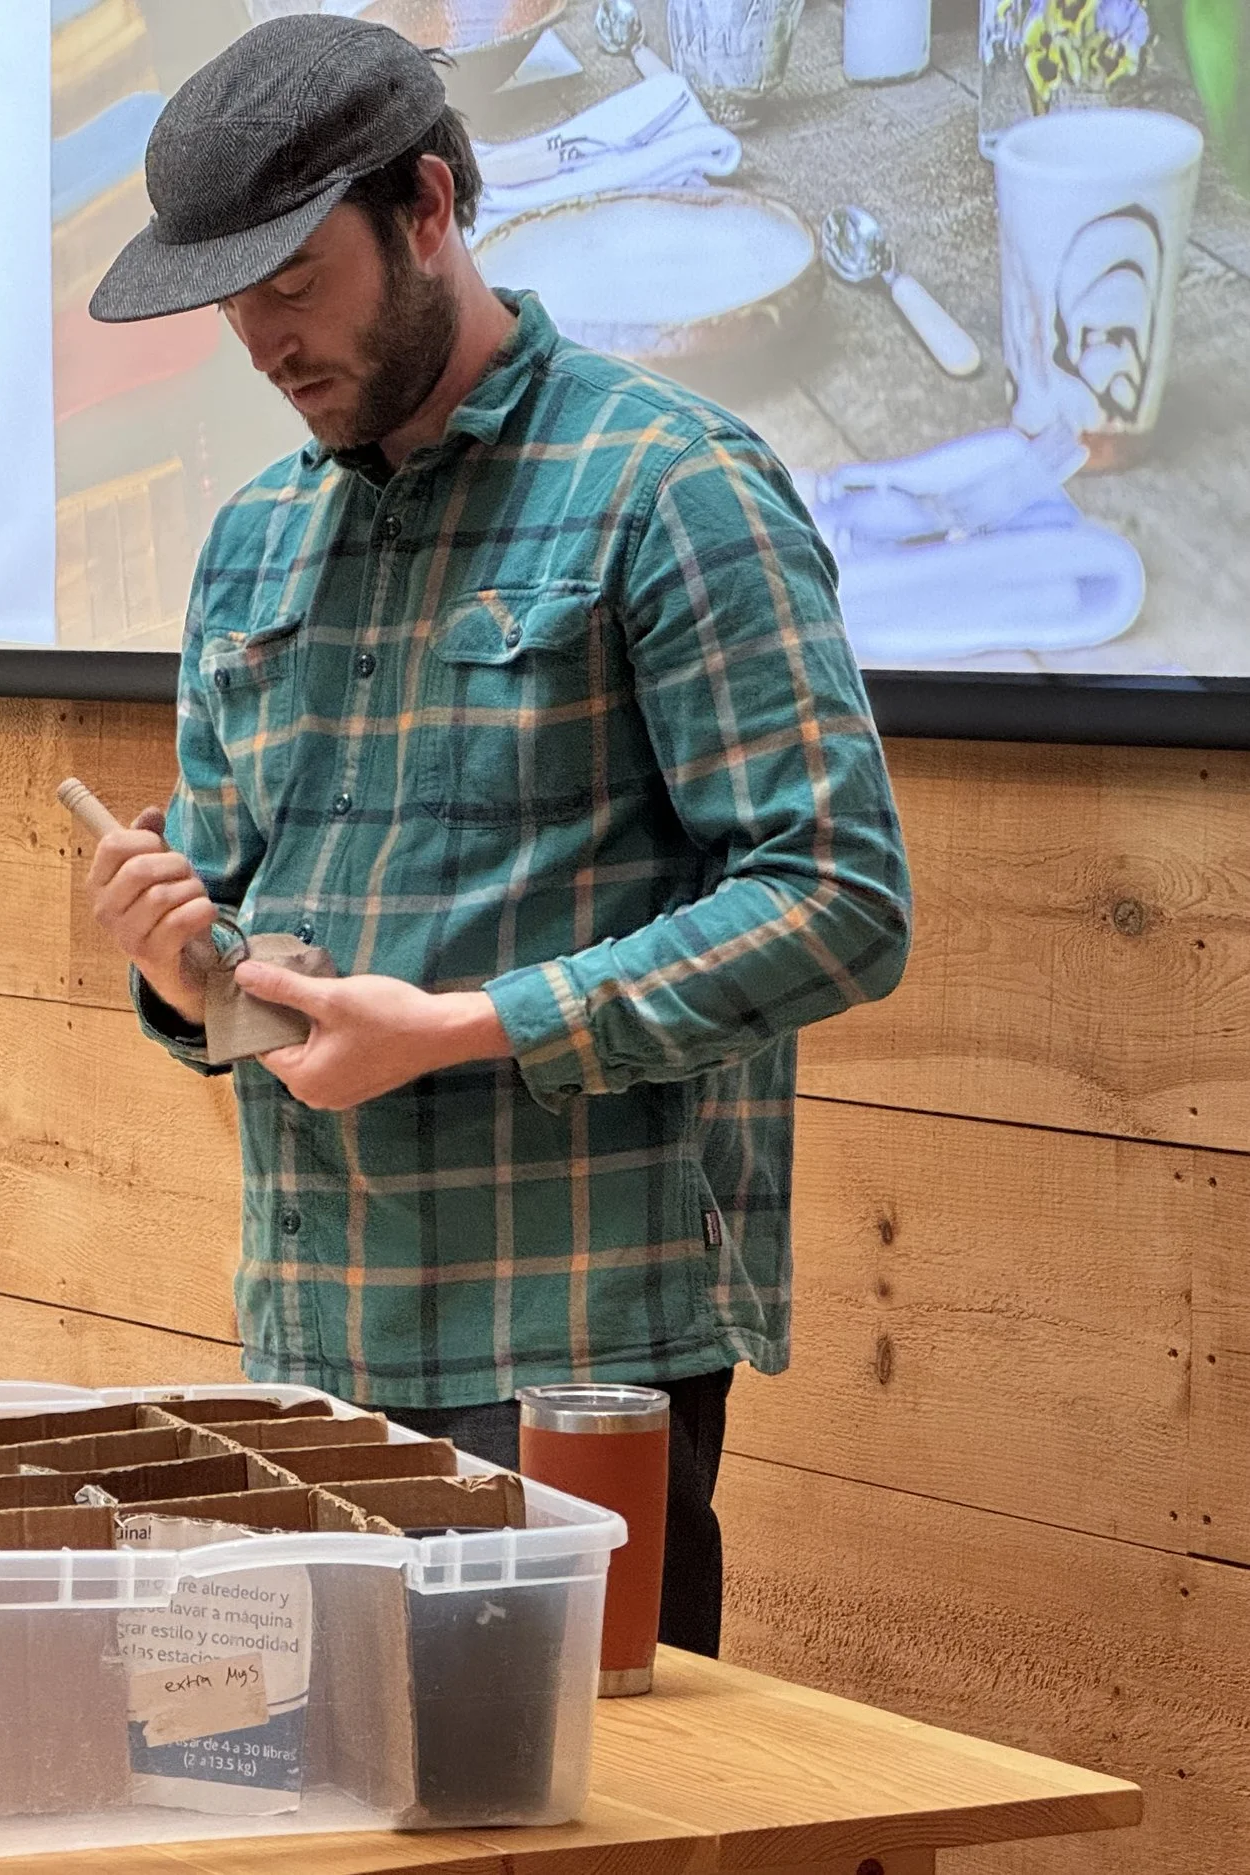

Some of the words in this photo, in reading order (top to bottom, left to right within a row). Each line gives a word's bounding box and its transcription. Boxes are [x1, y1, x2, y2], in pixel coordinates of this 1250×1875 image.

[202, 1582, 276, 1602] alrededor
[279, 1593, 289, 1609] y
[170, 1600, 207, 1618] lavar
[212, 1608, 221, 1620] a
[225, 1611, 292, 1630] máquina
[151, 1625, 193, 1641] estilo
[197, 1630, 207, 1646] y
[211, 1633, 299, 1653] comodidad
[164, 1674, 212, 1692] extra
[203, 1738, 219, 1751] de
[221, 1741, 230, 1752] 4
[232, 1743, 240, 1754] a
[243, 1743, 260, 1757] 30
[262, 1745, 297, 1761] libras
[237, 1760, 257, 1777] kg)
